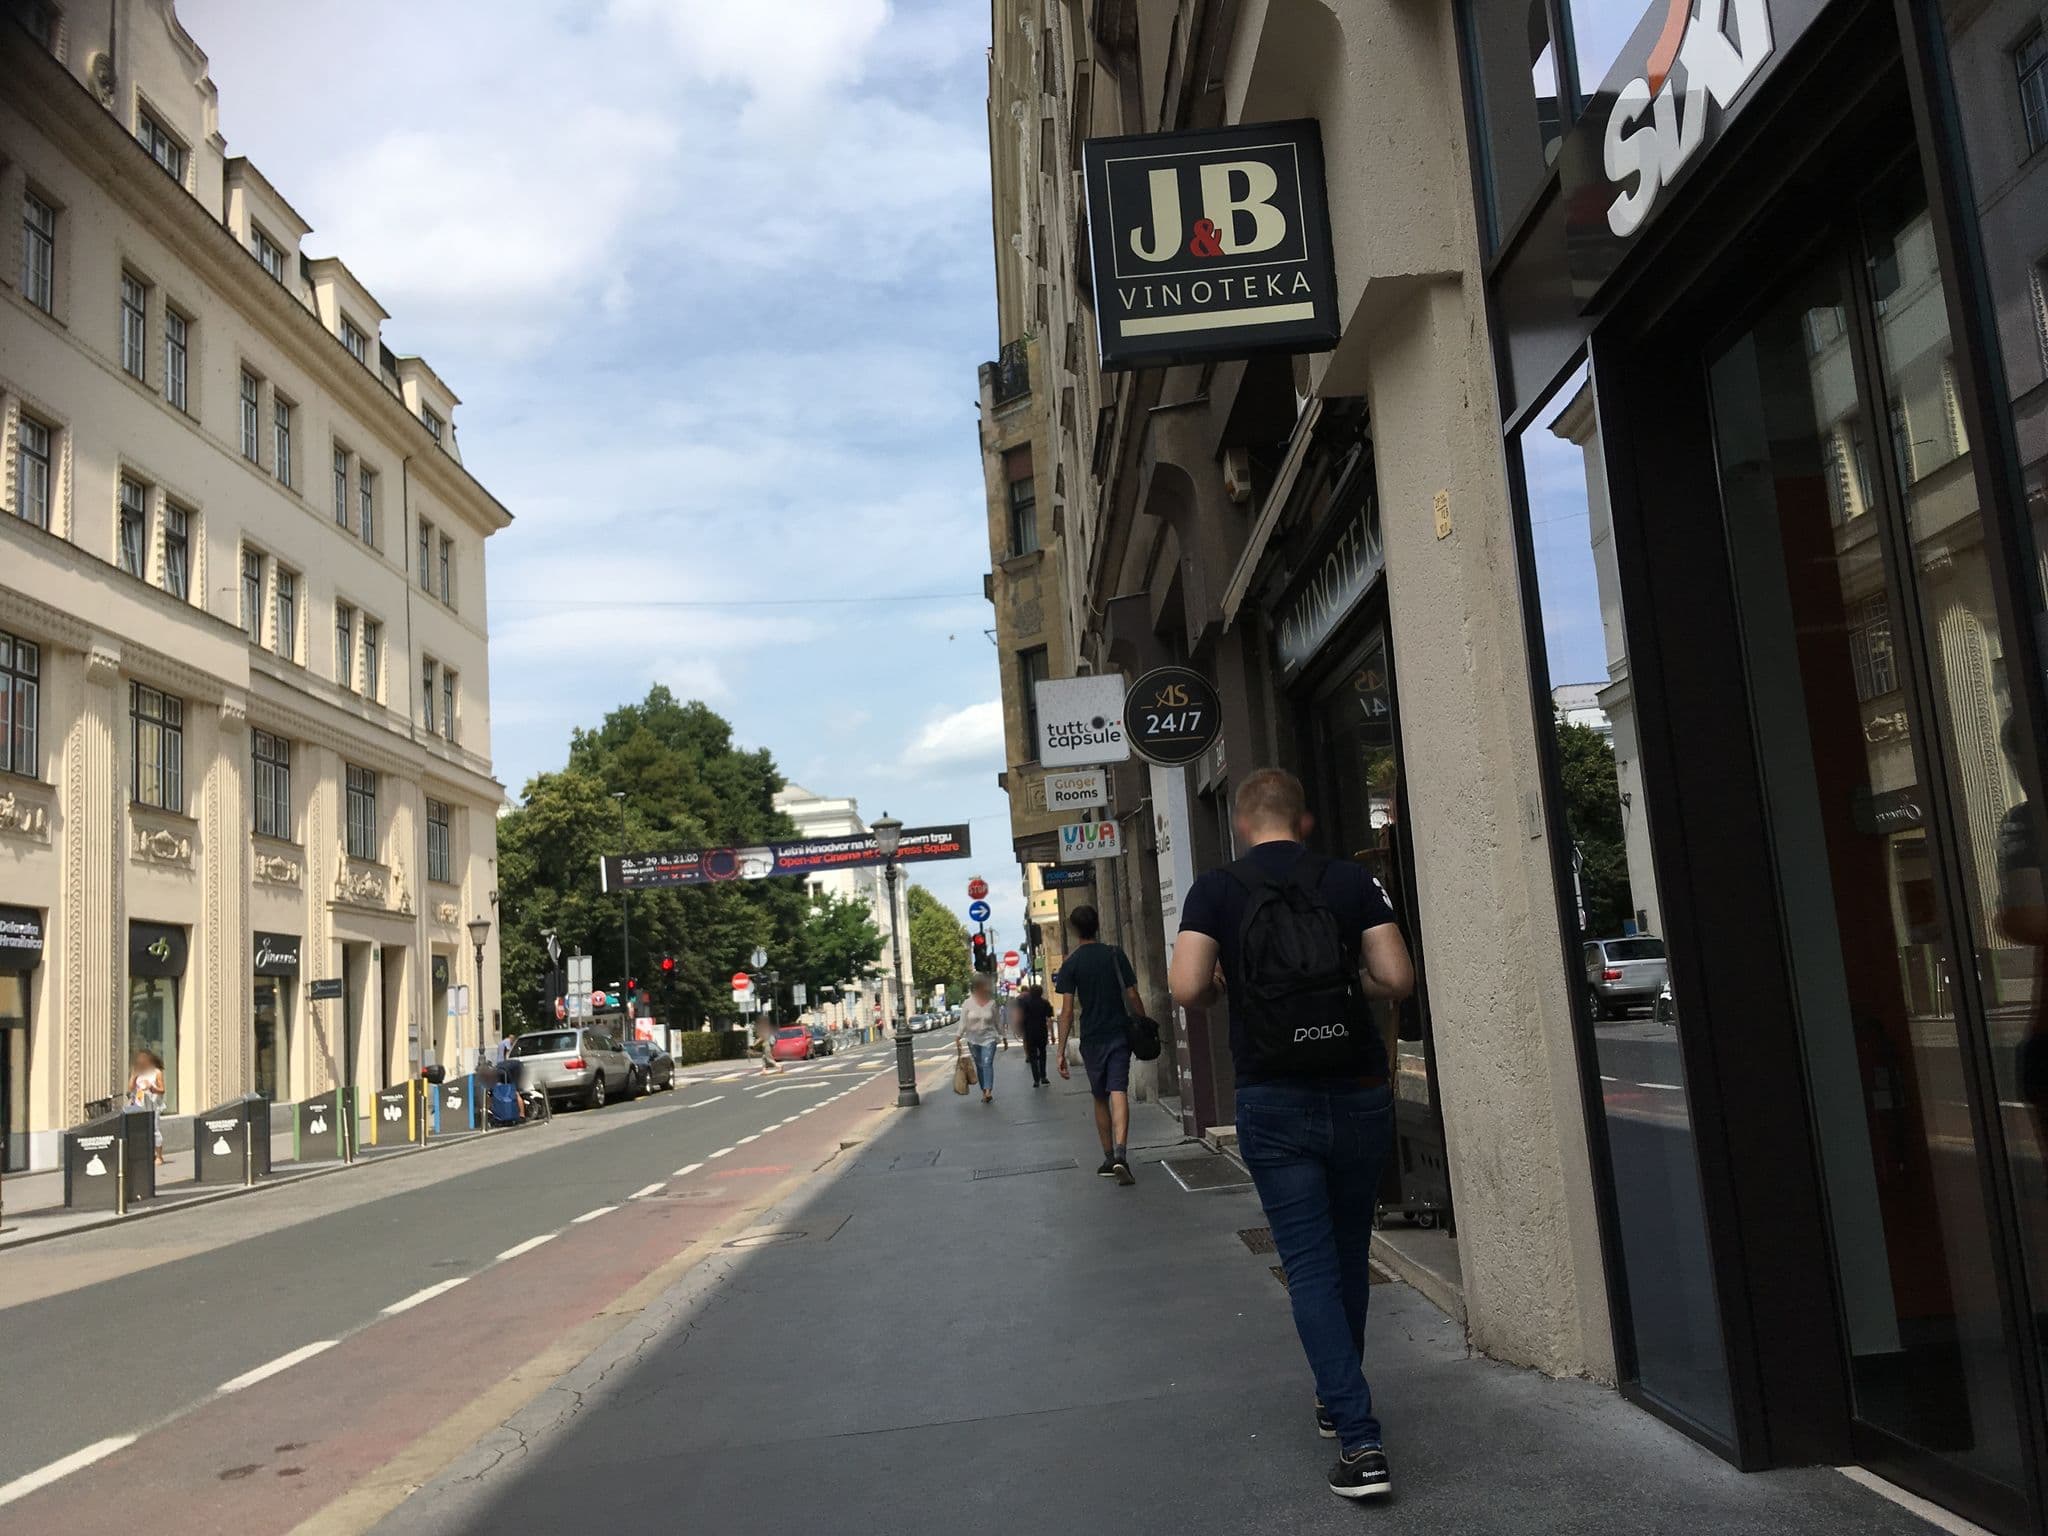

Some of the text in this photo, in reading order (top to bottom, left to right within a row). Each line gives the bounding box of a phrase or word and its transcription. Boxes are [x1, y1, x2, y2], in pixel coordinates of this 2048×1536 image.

[1129, 160, 1288, 263] J&B
[1117, 270, 1312, 311] VINOTEKA
[1155, 683, 1190, 708] AS
[1146, 711, 1202, 735] 24/7
[1047, 728, 1121, 750] capsule
[1054, 775, 1096, 791] Ginger
[1055, 787, 1098, 802] Rooms
[1063, 822, 1115, 844] VIVA
[805, 843, 851, 855] Kinodvor
[823, 851, 861, 863] Cinema
[923, 842, 960, 855] Square
[1064, 839, 1116, 852] ROOMS
[968, 884, 988, 895] STOP
[1293, 1023, 1345, 1042] POLO
